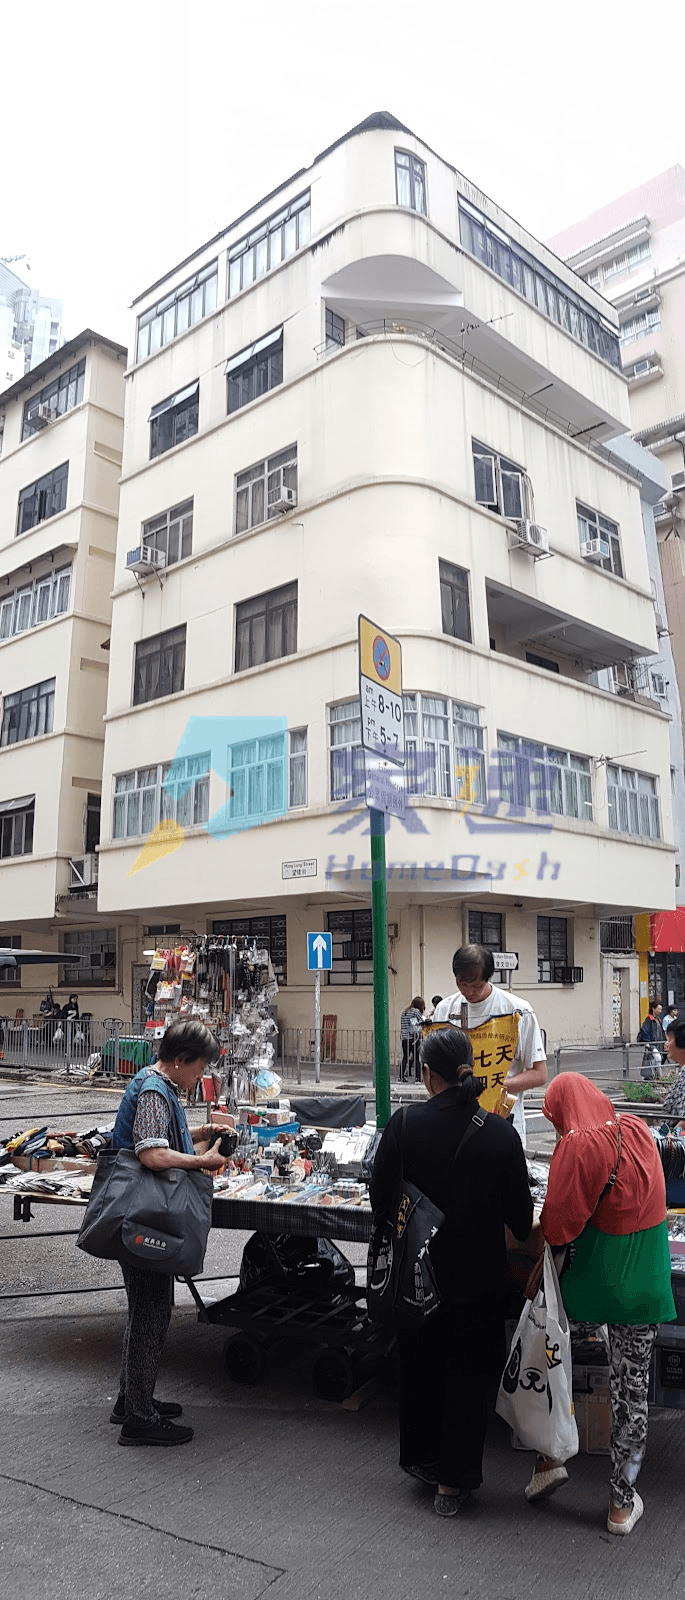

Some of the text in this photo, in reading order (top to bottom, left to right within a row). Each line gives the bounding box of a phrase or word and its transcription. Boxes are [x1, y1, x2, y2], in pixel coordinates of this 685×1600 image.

[365, 685, 373, 694] am
[365, 694, 402, 722] 上午 8-10
[367, 717, 375, 726] pm
[365, 726, 398, 751] 下午 5-7
[474, 1044, 513, 1068] 七天
